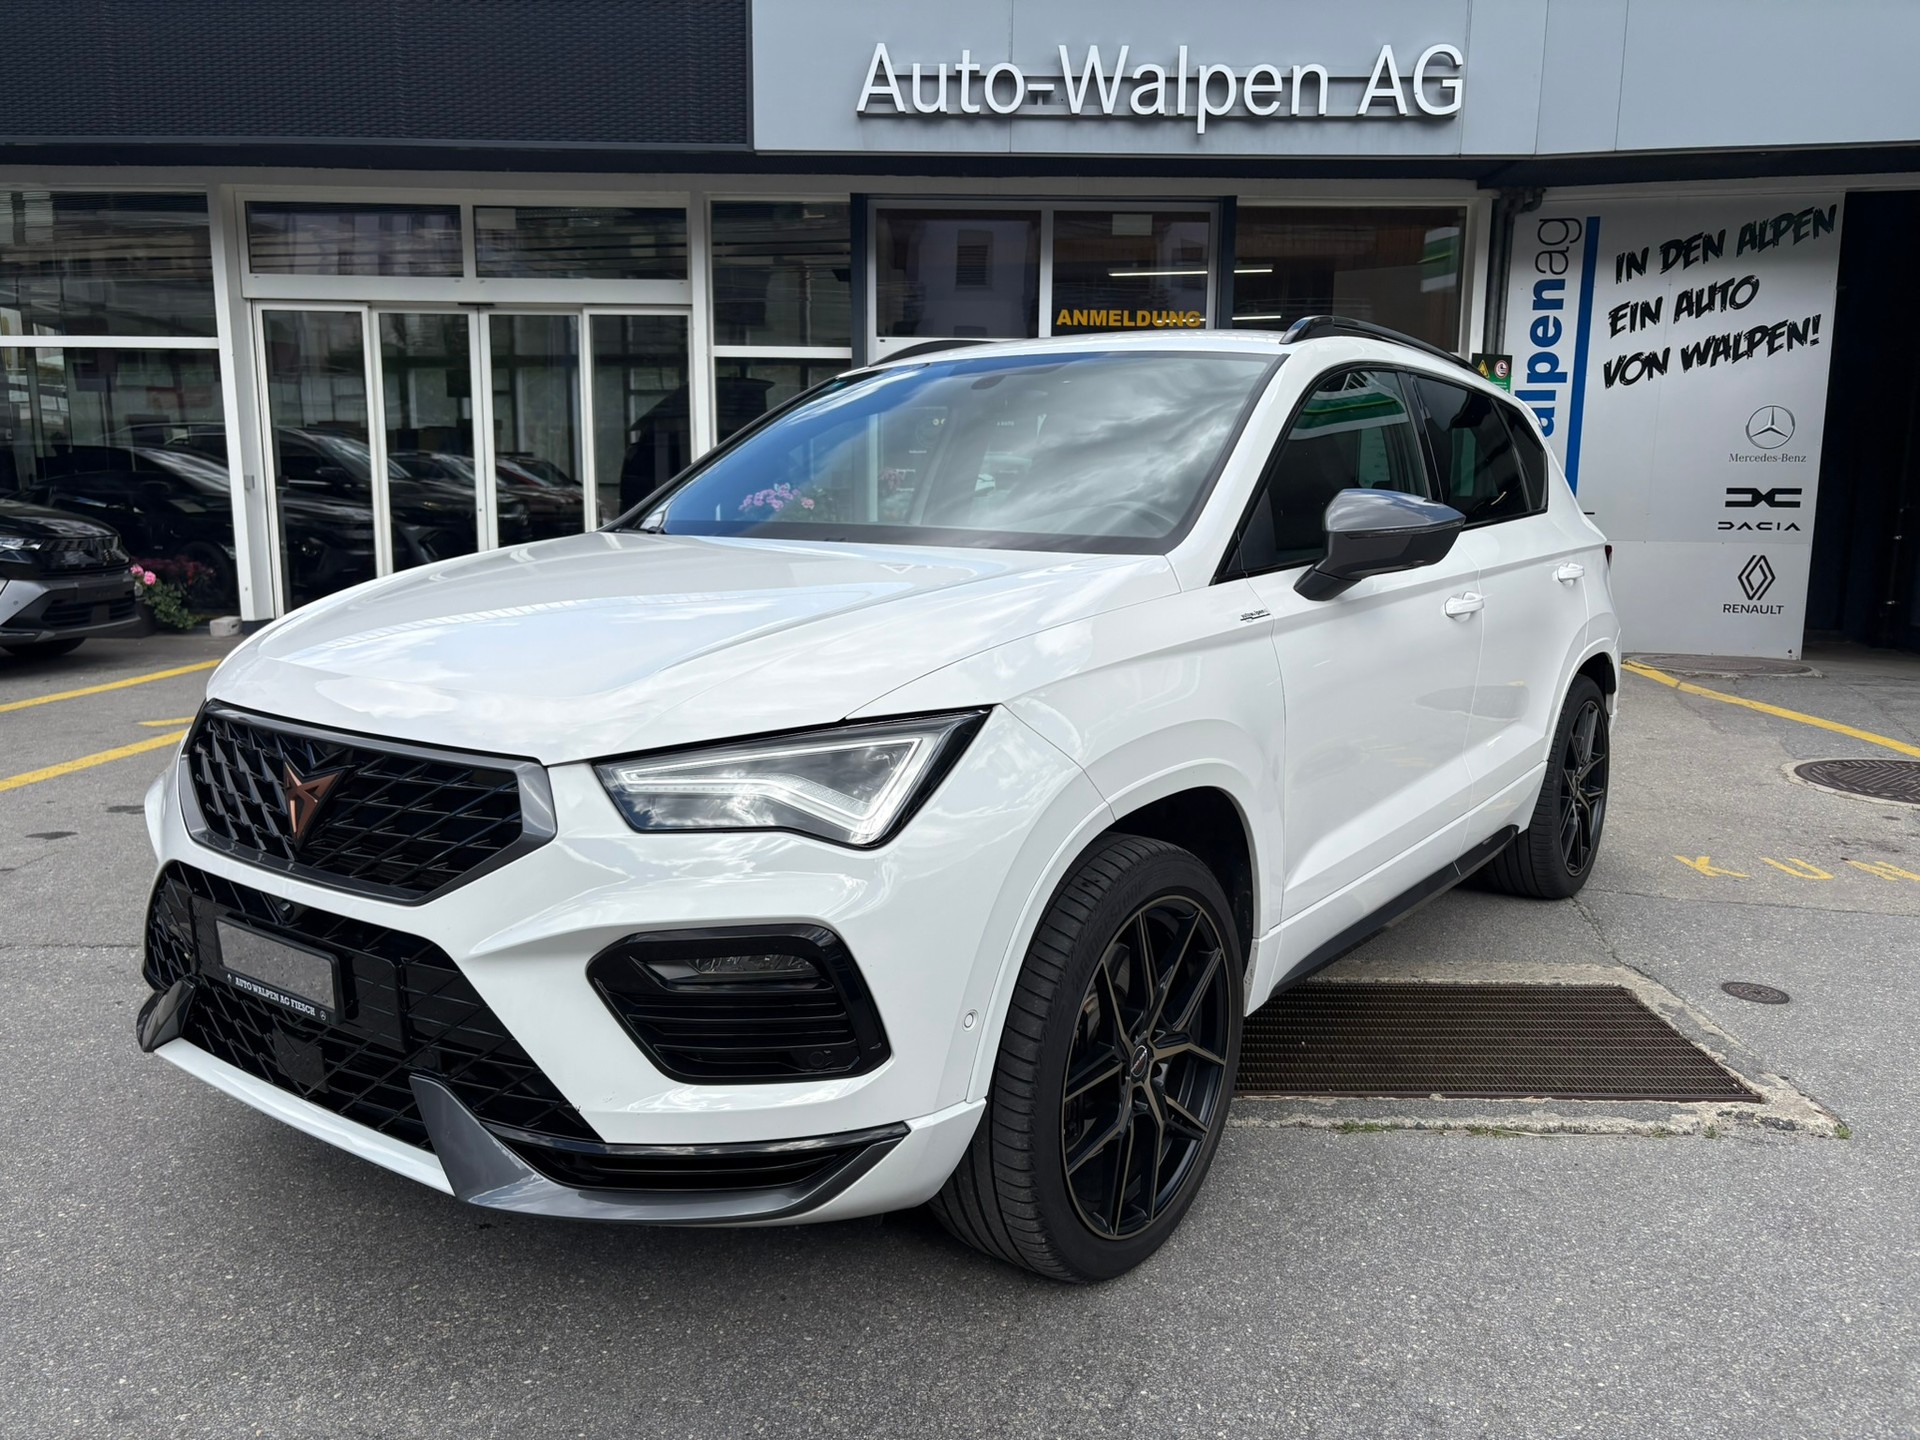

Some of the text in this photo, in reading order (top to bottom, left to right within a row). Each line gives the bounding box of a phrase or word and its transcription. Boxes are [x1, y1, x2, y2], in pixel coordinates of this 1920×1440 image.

[857, 42, 1465, 134] Auto-Walpen AG
[1616, 204, 1837, 285] IN DEN ALPEN
[1056, 309, 1201, 327] ANMELDUNG
[1608, 275, 1760, 338] EIN AUTO
[1603, 314, 1822, 389] VON WALPEN!
[1728, 453, 1807, 463] Mercedes-Benz
[1717, 521, 1801, 531] DACIA
[1722, 604, 1784, 615] RENAULT
[235, 977, 316, 1016] AUTO WALPEN AG FIESCH
